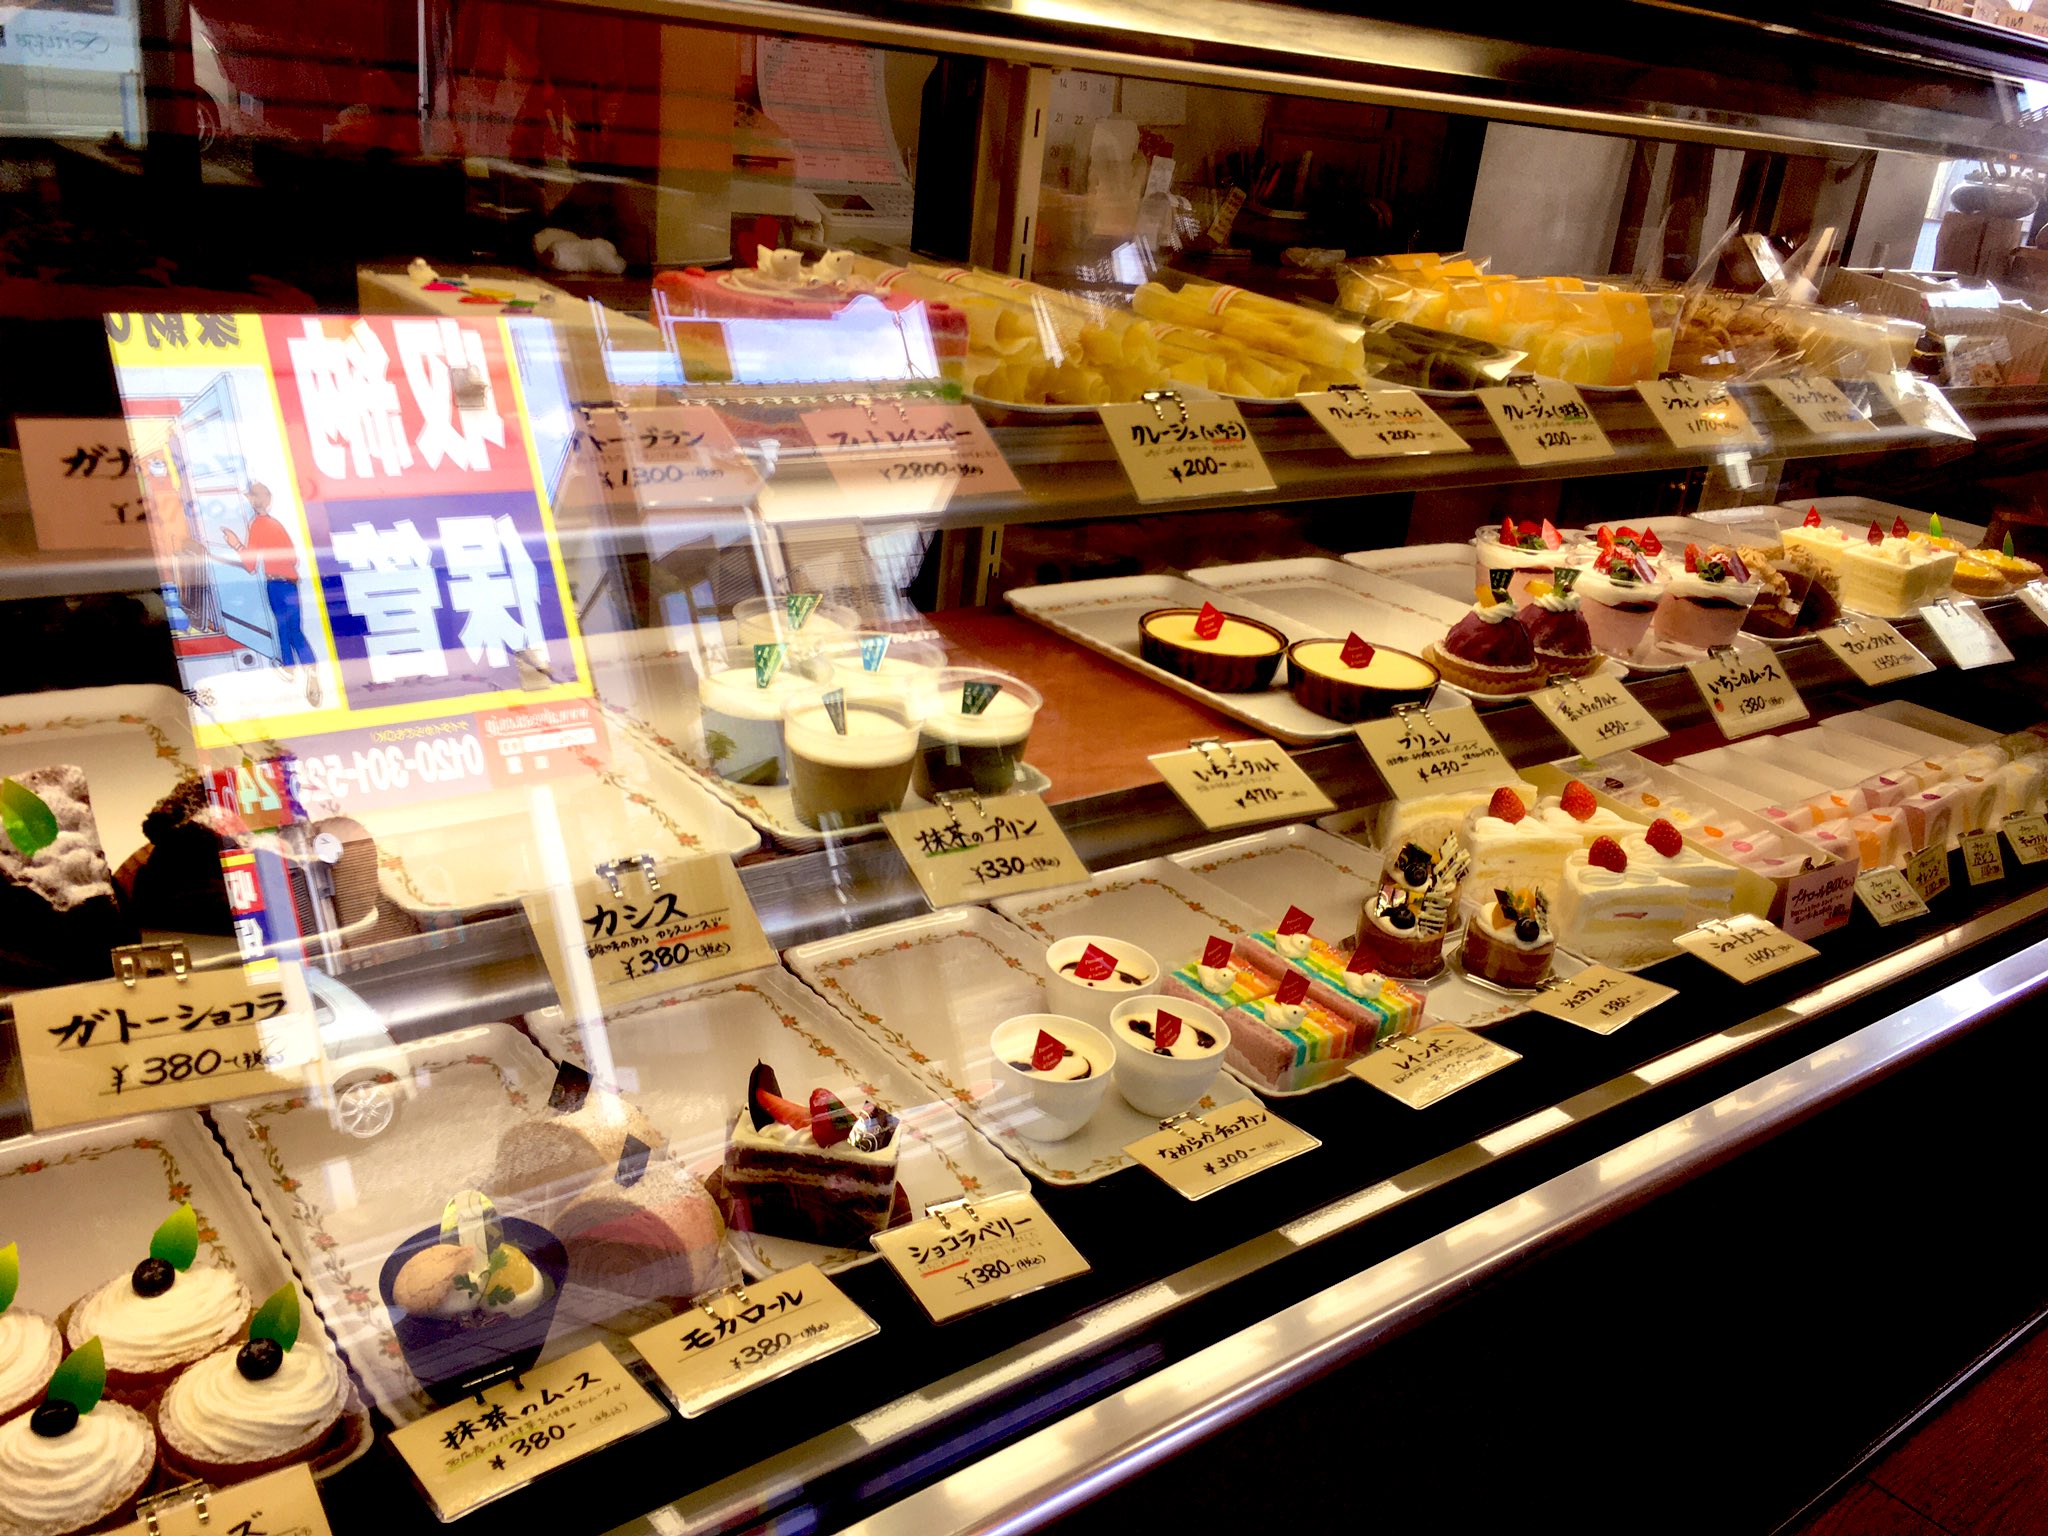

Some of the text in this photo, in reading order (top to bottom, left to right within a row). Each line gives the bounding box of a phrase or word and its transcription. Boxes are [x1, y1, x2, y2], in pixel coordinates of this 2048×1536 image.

[1060, 78, 1068, 89] 14
[1080, 81, 1088, 91] 15
[1707, 664, 1781, 694] いちごのムース
[914, 816, 1039, 854] 抹茶のプリン
[583, 892, 689, 939] カシス
[47, 990, 288, 1048] ガトーショコラ
[908, 1215, 1033, 1265] ショコラベリー
[679, 1289, 804, 1352] モカロール
[440, 1371, 603, 1451] 抹茶のムース
